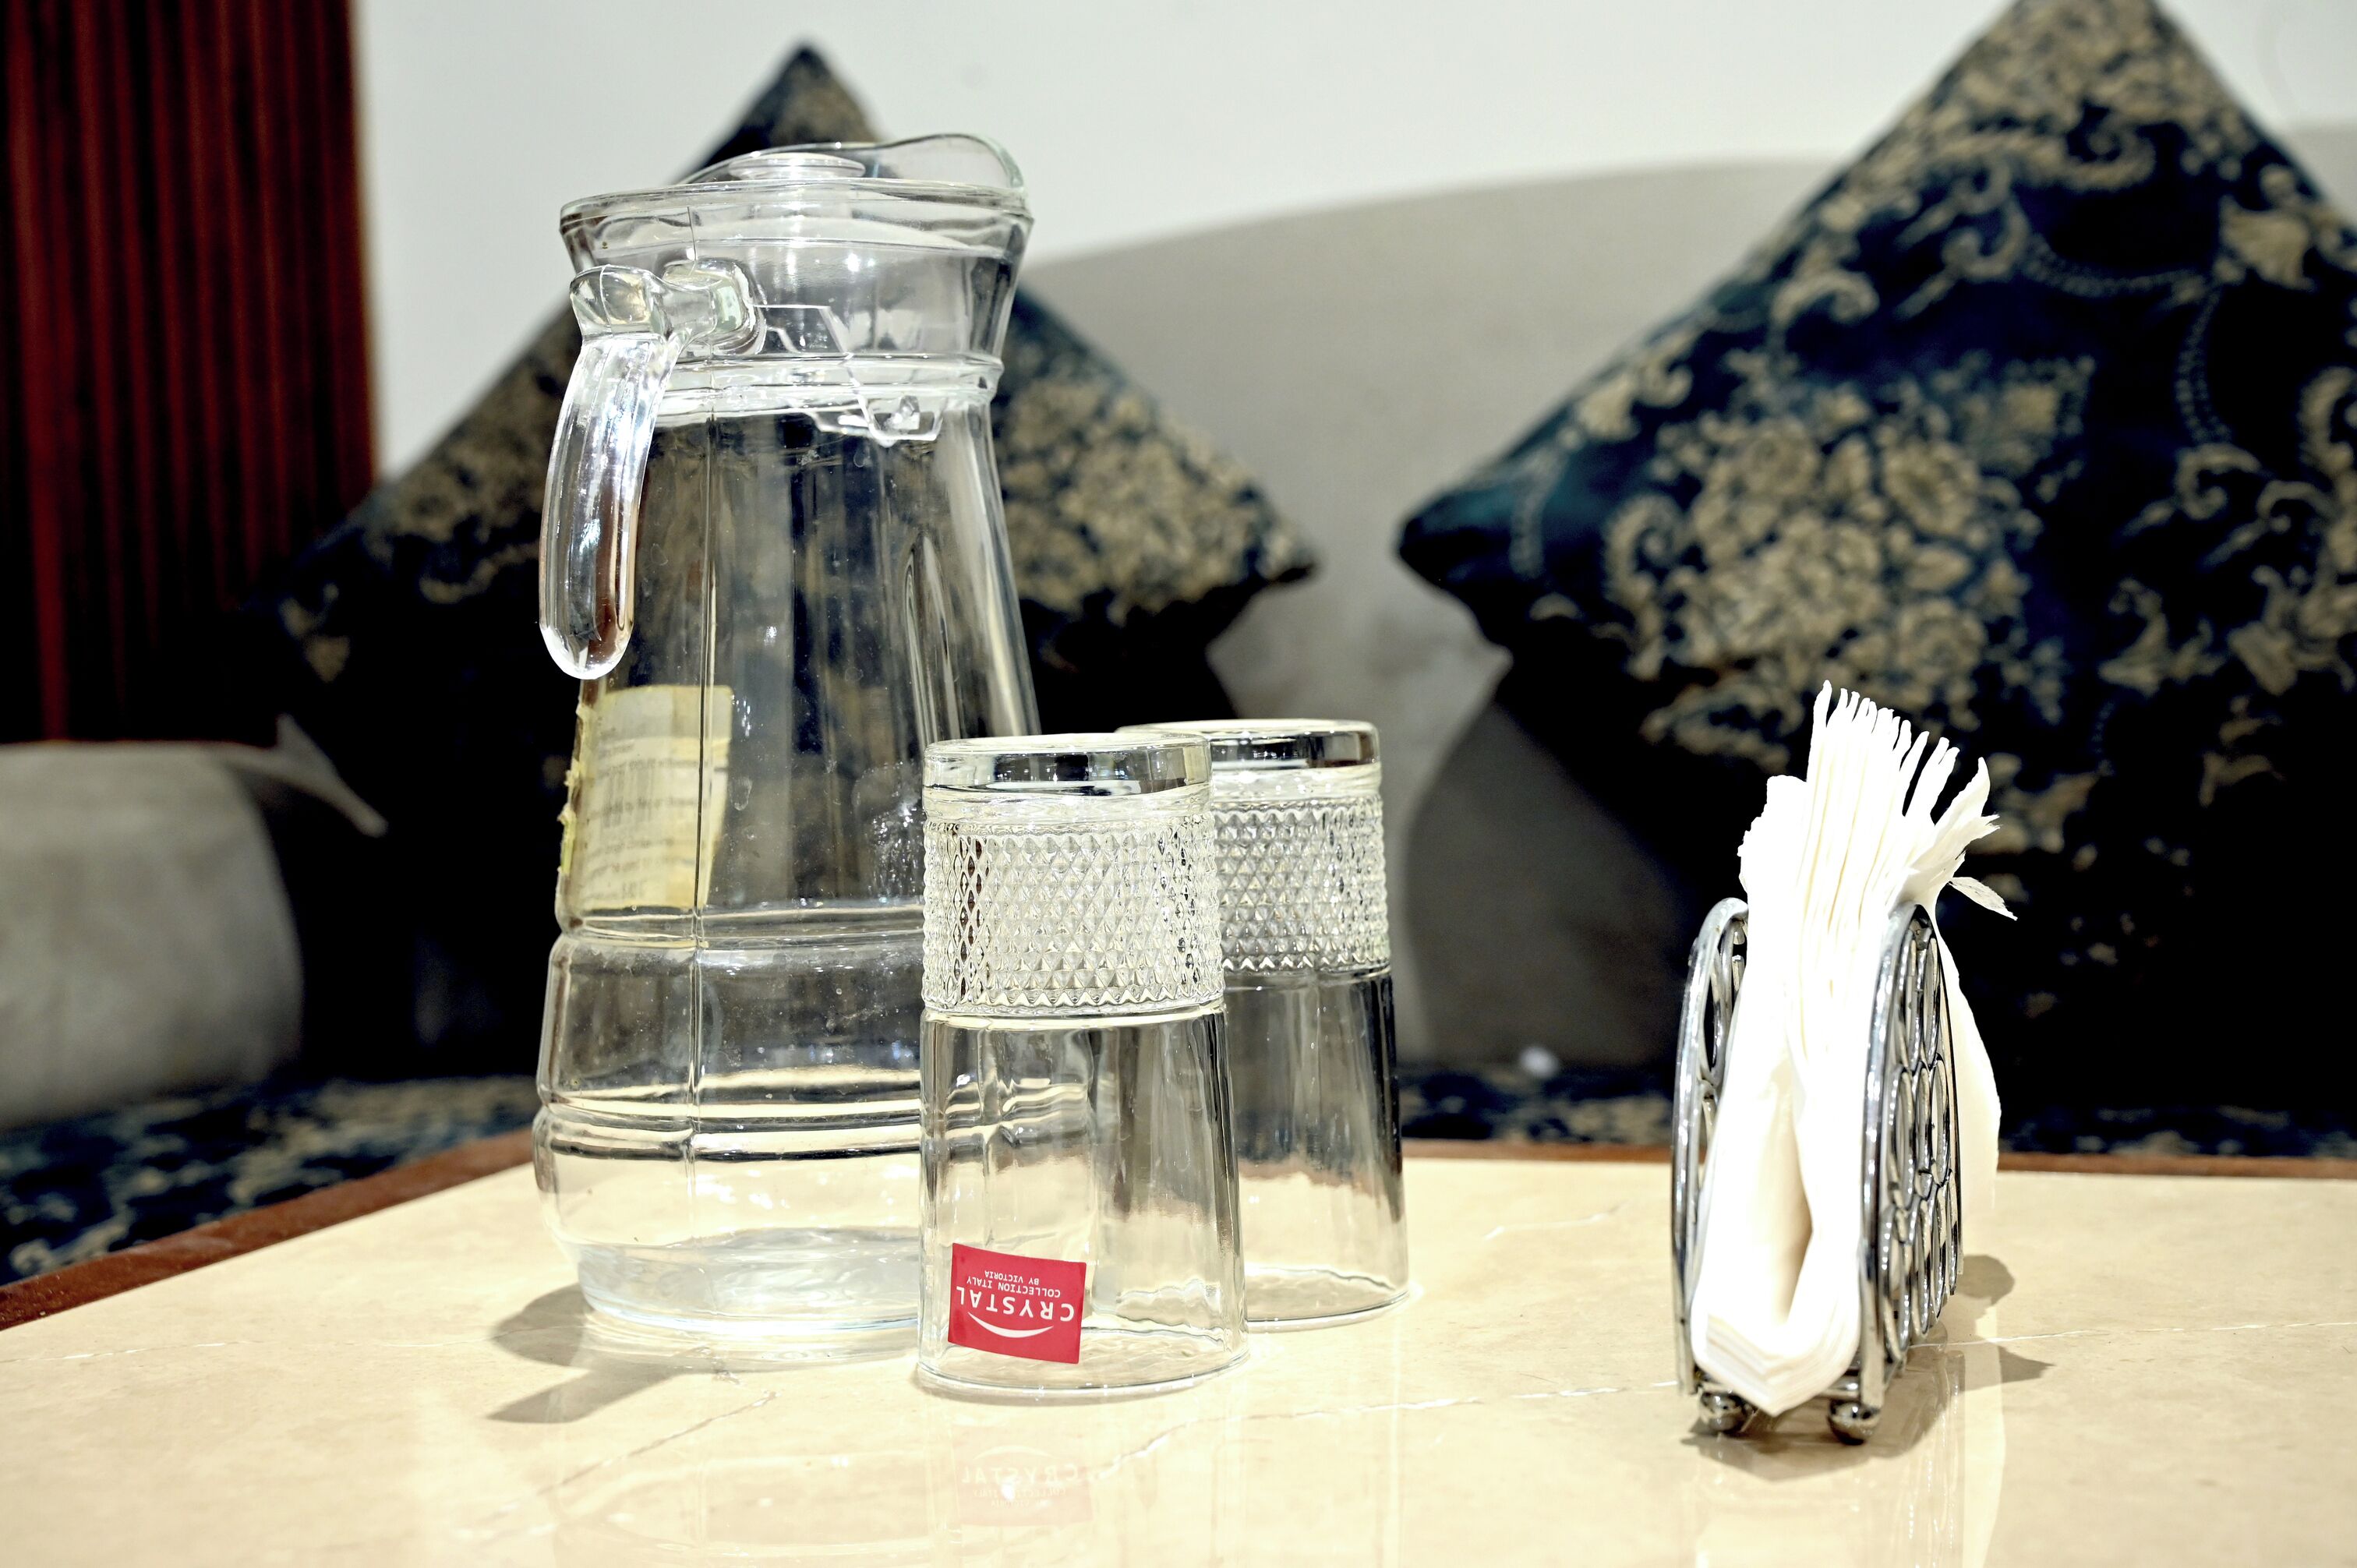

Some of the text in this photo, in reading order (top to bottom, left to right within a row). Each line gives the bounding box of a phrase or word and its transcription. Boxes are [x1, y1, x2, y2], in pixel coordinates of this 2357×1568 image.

[966, 1276, 1061, 1298] COLLECTION ITALY
[984, 1270, 1023, 1283] VICTORIA
[956, 1286, 1074, 1322] CRYSTAL
